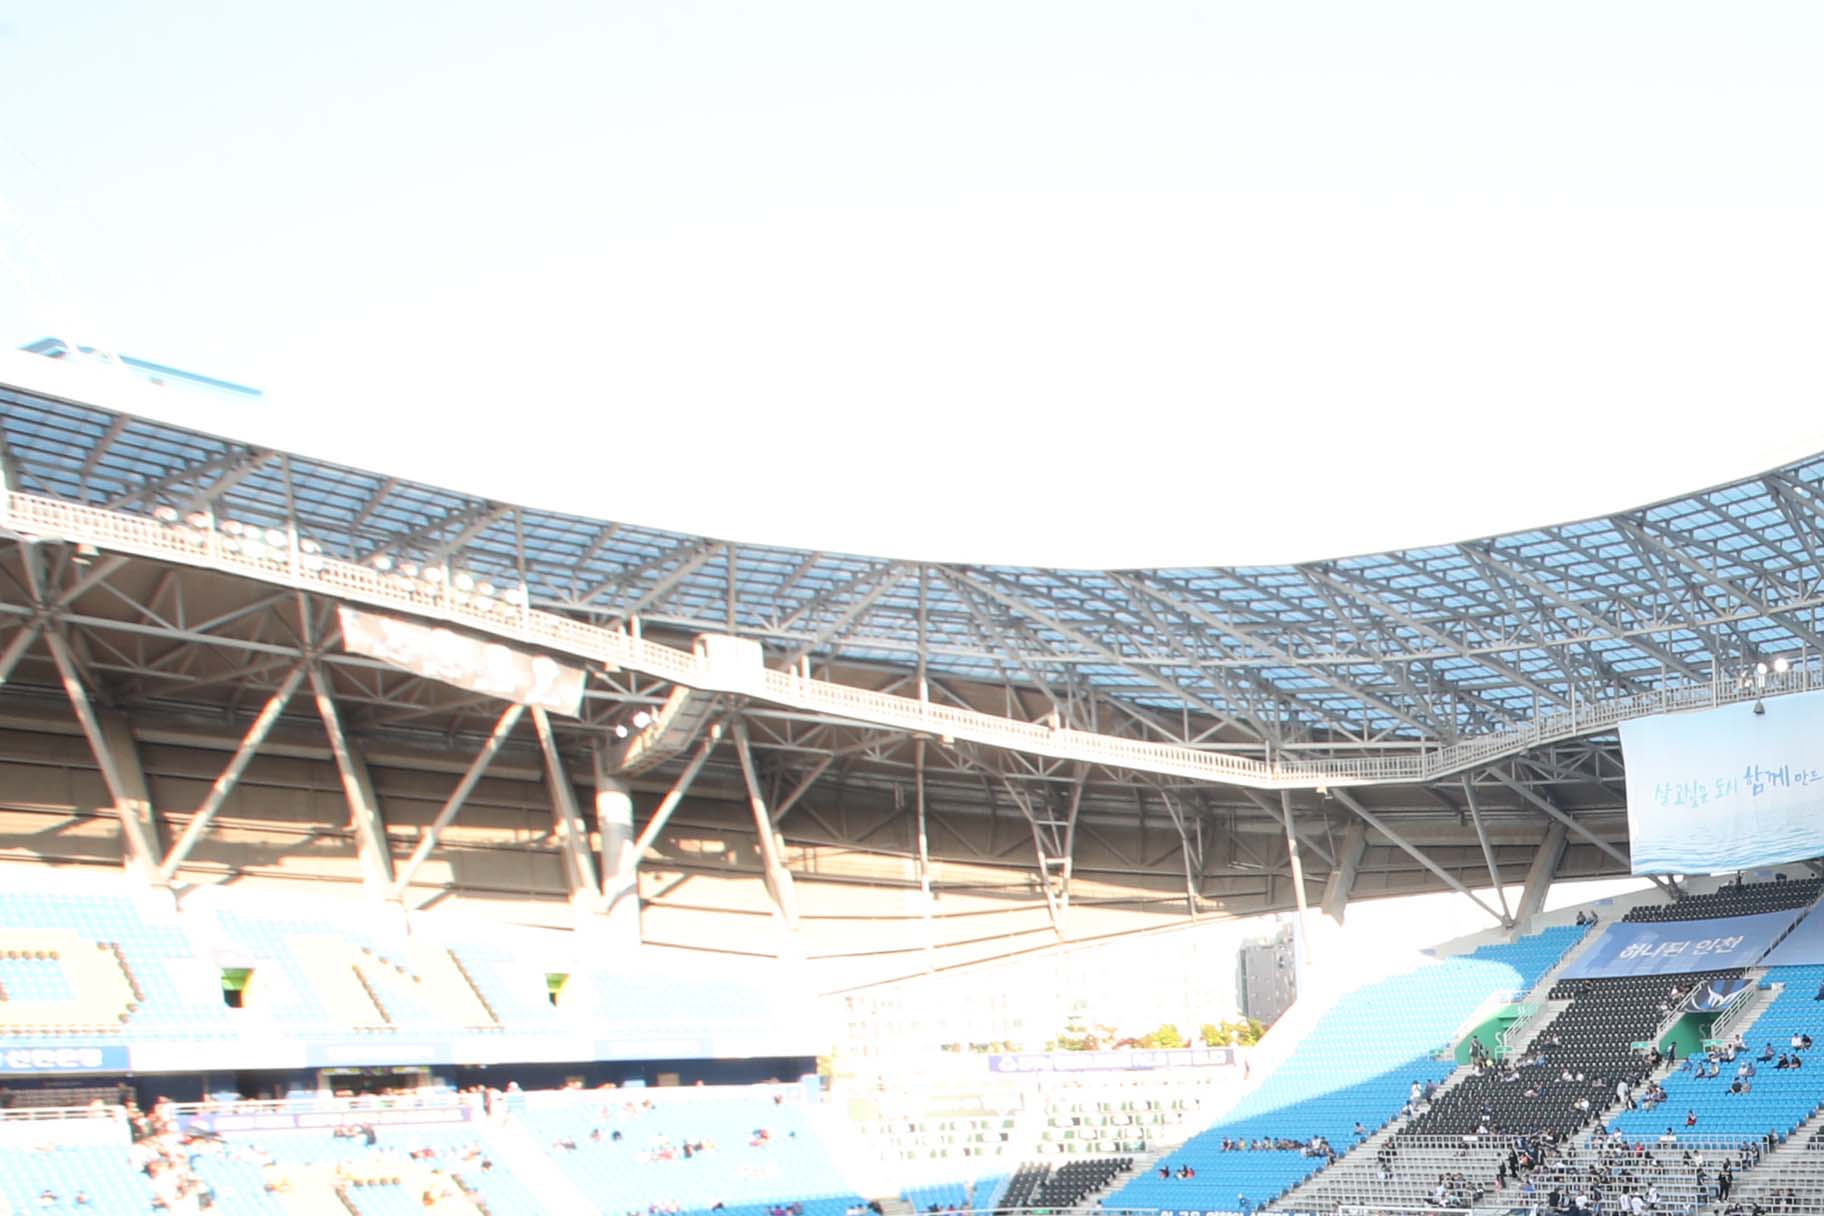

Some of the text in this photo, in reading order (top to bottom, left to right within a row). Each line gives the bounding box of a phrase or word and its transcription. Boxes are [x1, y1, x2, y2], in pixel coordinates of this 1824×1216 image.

[1743, 764, 1791, 797] 함께
[1619, 935, 1745, 961] 하나된 인천
